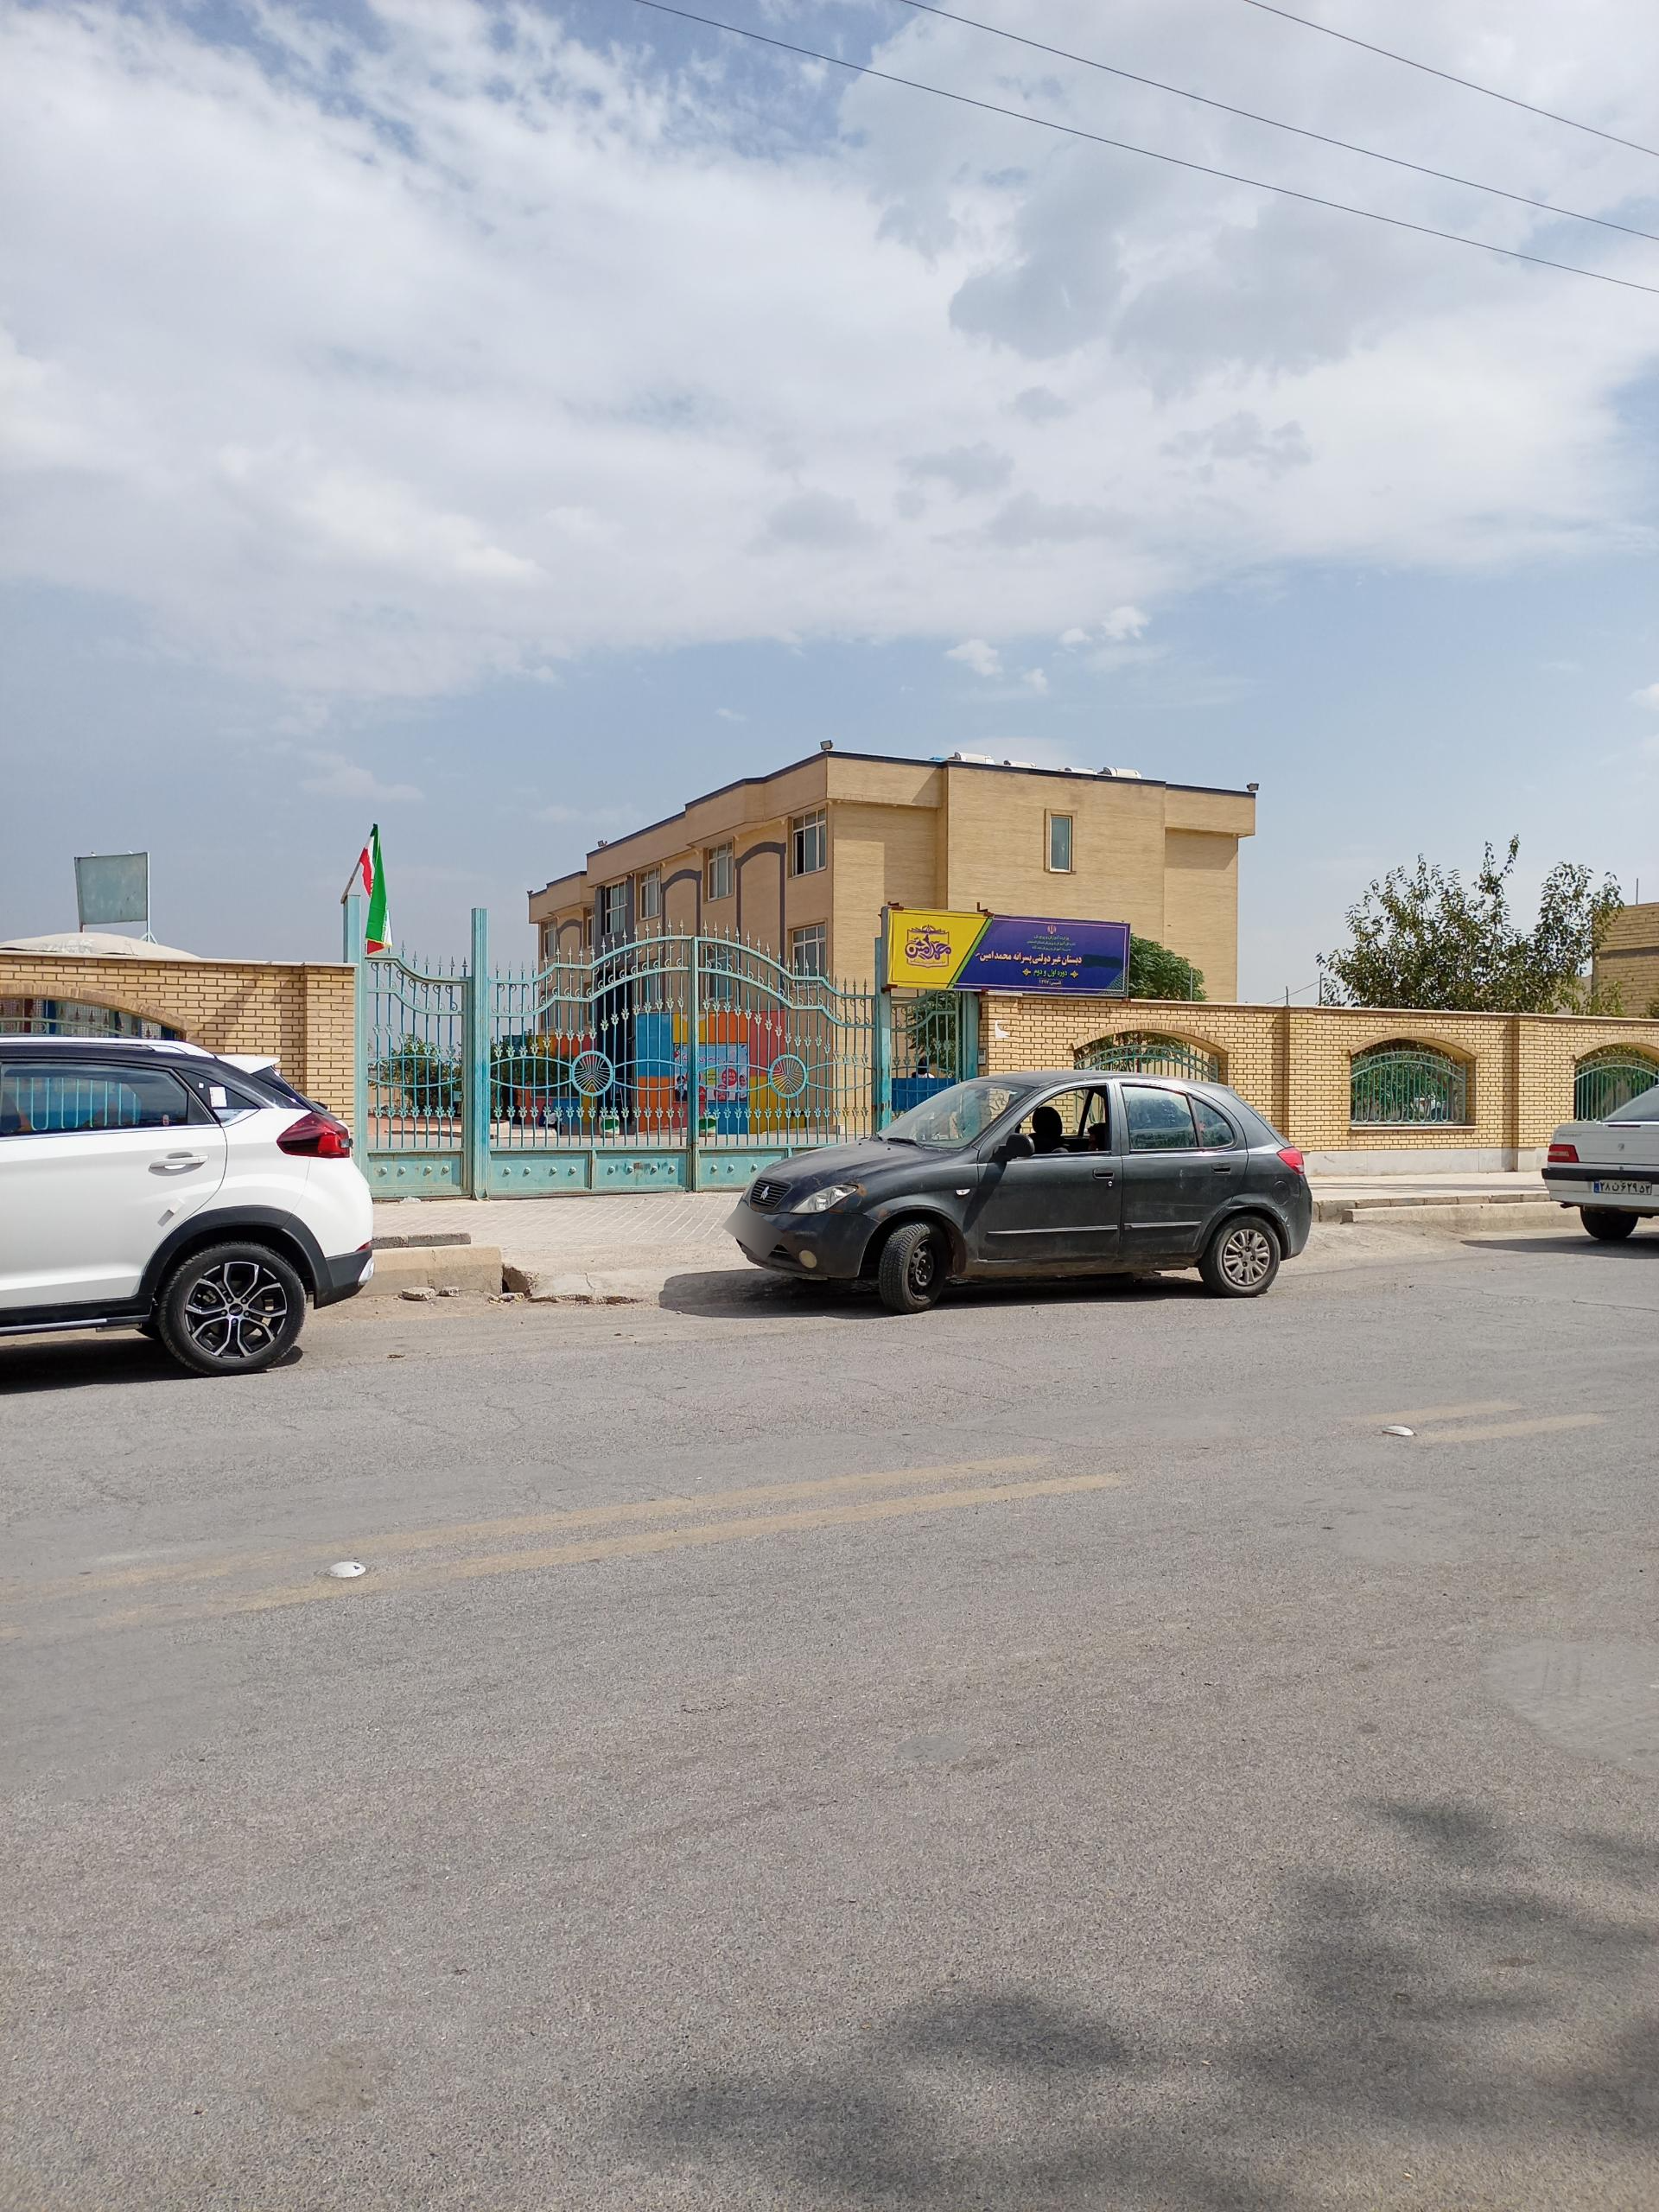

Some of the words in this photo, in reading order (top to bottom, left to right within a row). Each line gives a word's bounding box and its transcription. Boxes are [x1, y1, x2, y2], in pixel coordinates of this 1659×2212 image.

[979, 950, 995, 962] امین
[994, 952, 1012, 961] محمد
[1013, 951, 1033, 965] پسرانه
[1032, 953, 1051, 965] دولتی
[1050, 954, 1061, 966] غیر
[1061, 954, 1082, 966] دبستان
[1046, 969, 1057, 977] اول
[1057, 969, 1068, 978] دوره
